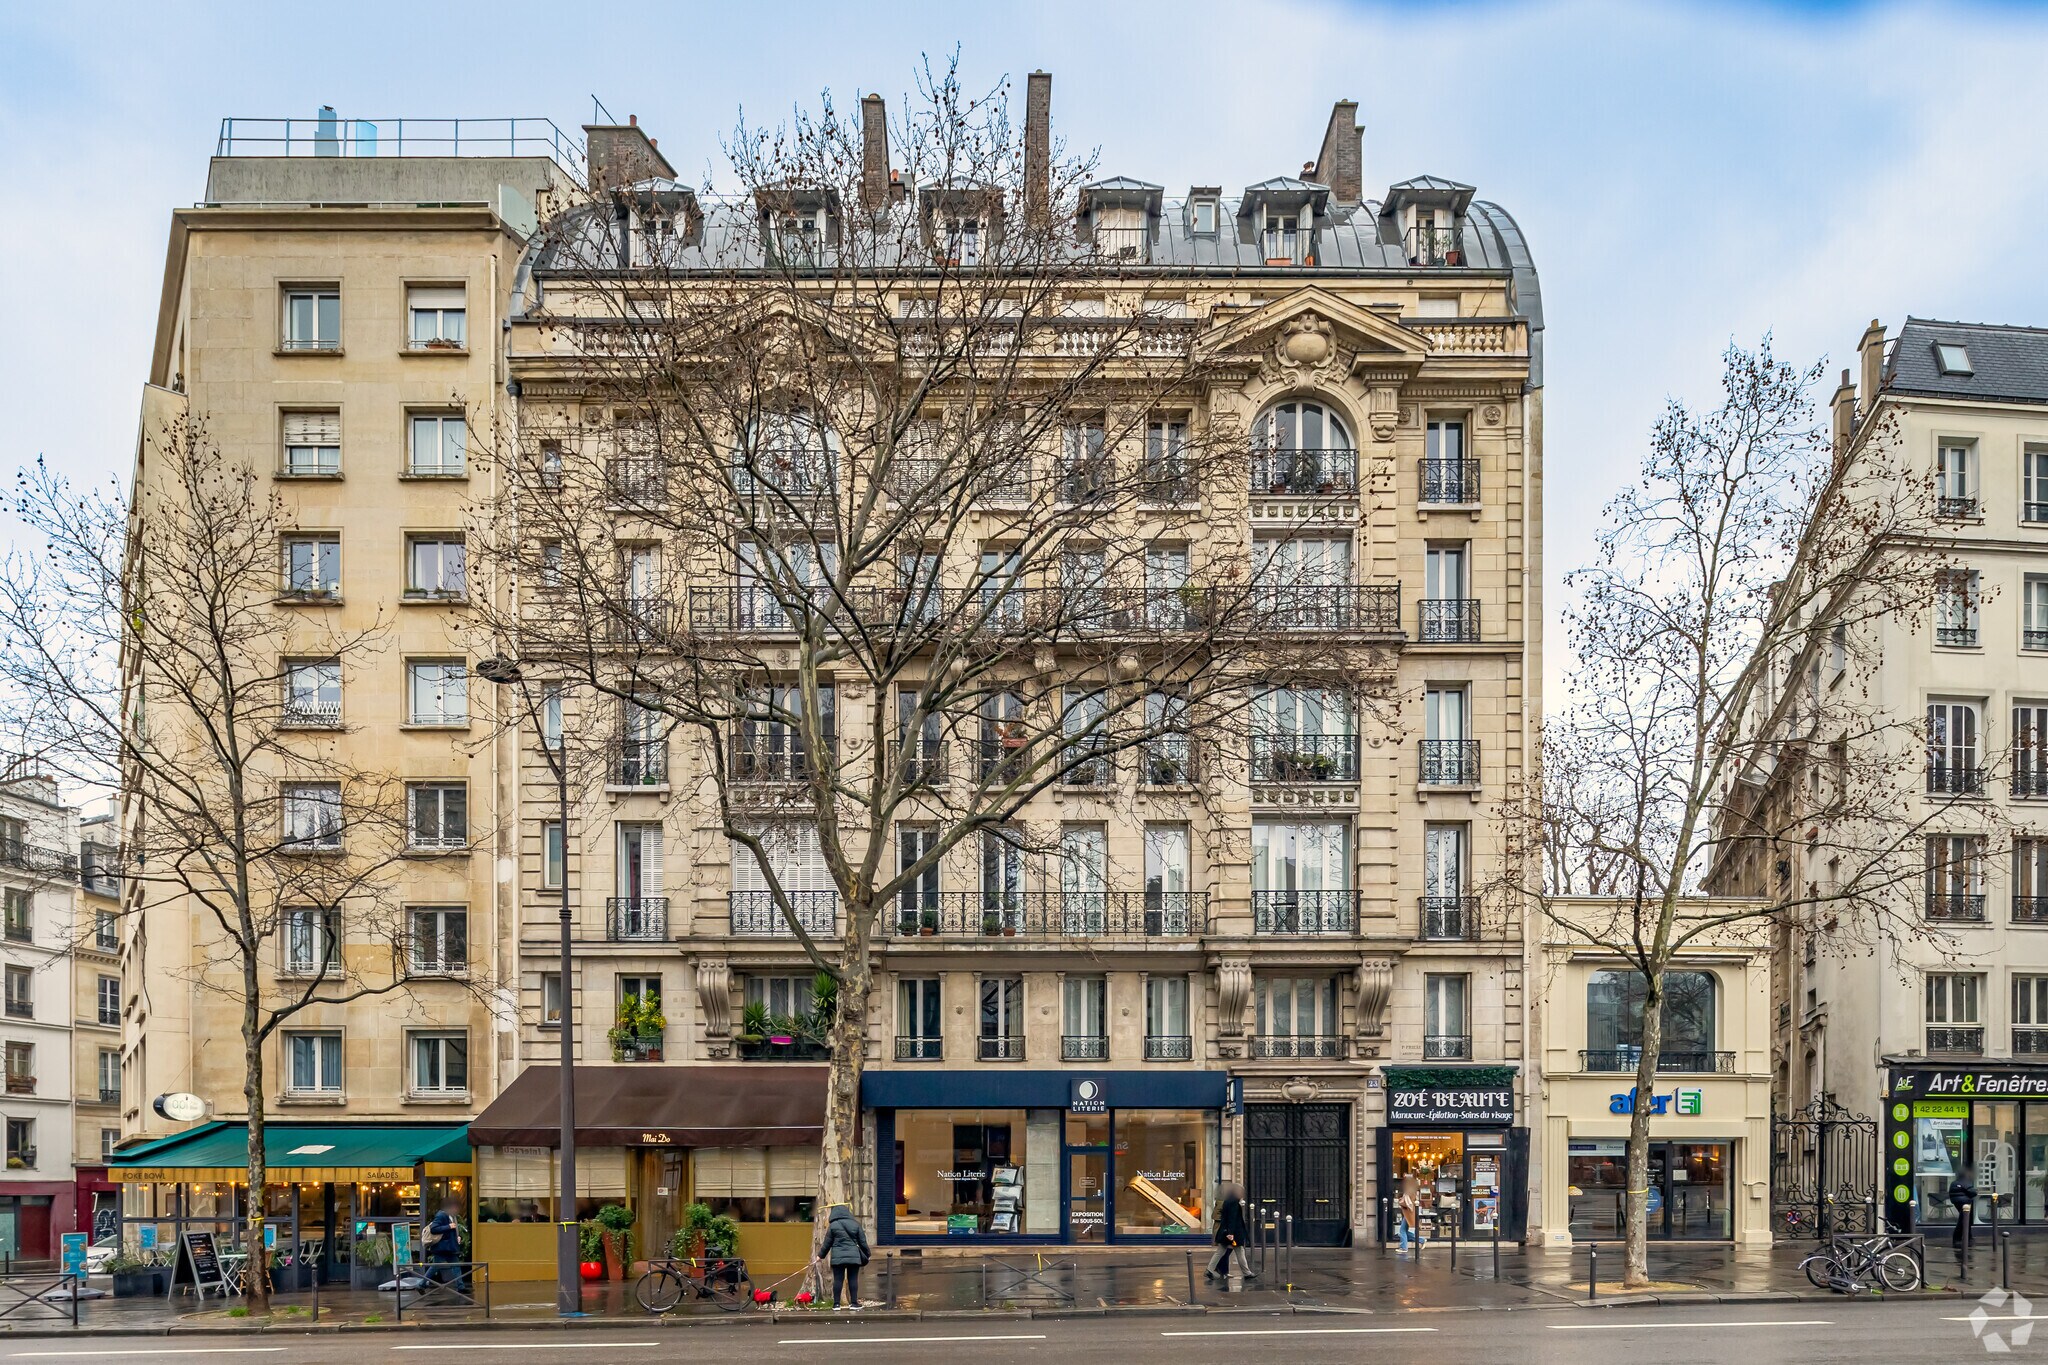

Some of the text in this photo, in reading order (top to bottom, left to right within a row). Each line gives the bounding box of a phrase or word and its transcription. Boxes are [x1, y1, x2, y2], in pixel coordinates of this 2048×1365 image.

[1928, 1073, 2048, 1093] Art&Fenêtre
[1393, 1089, 1509, 1107] ZOÉ BEAUTE
[1480, 1110, 1490, 1119] du
[1491, 1110, 1513, 1121] visage
[642, 1133, 657, 1143] Mai
[144, 1172, 166, 1180] BOWL
[367, 1171, 399, 1179] SALADES
[937, 1170, 986, 1178] Nation Literie
[1136, 1170, 1185, 1178] Nation Literie
